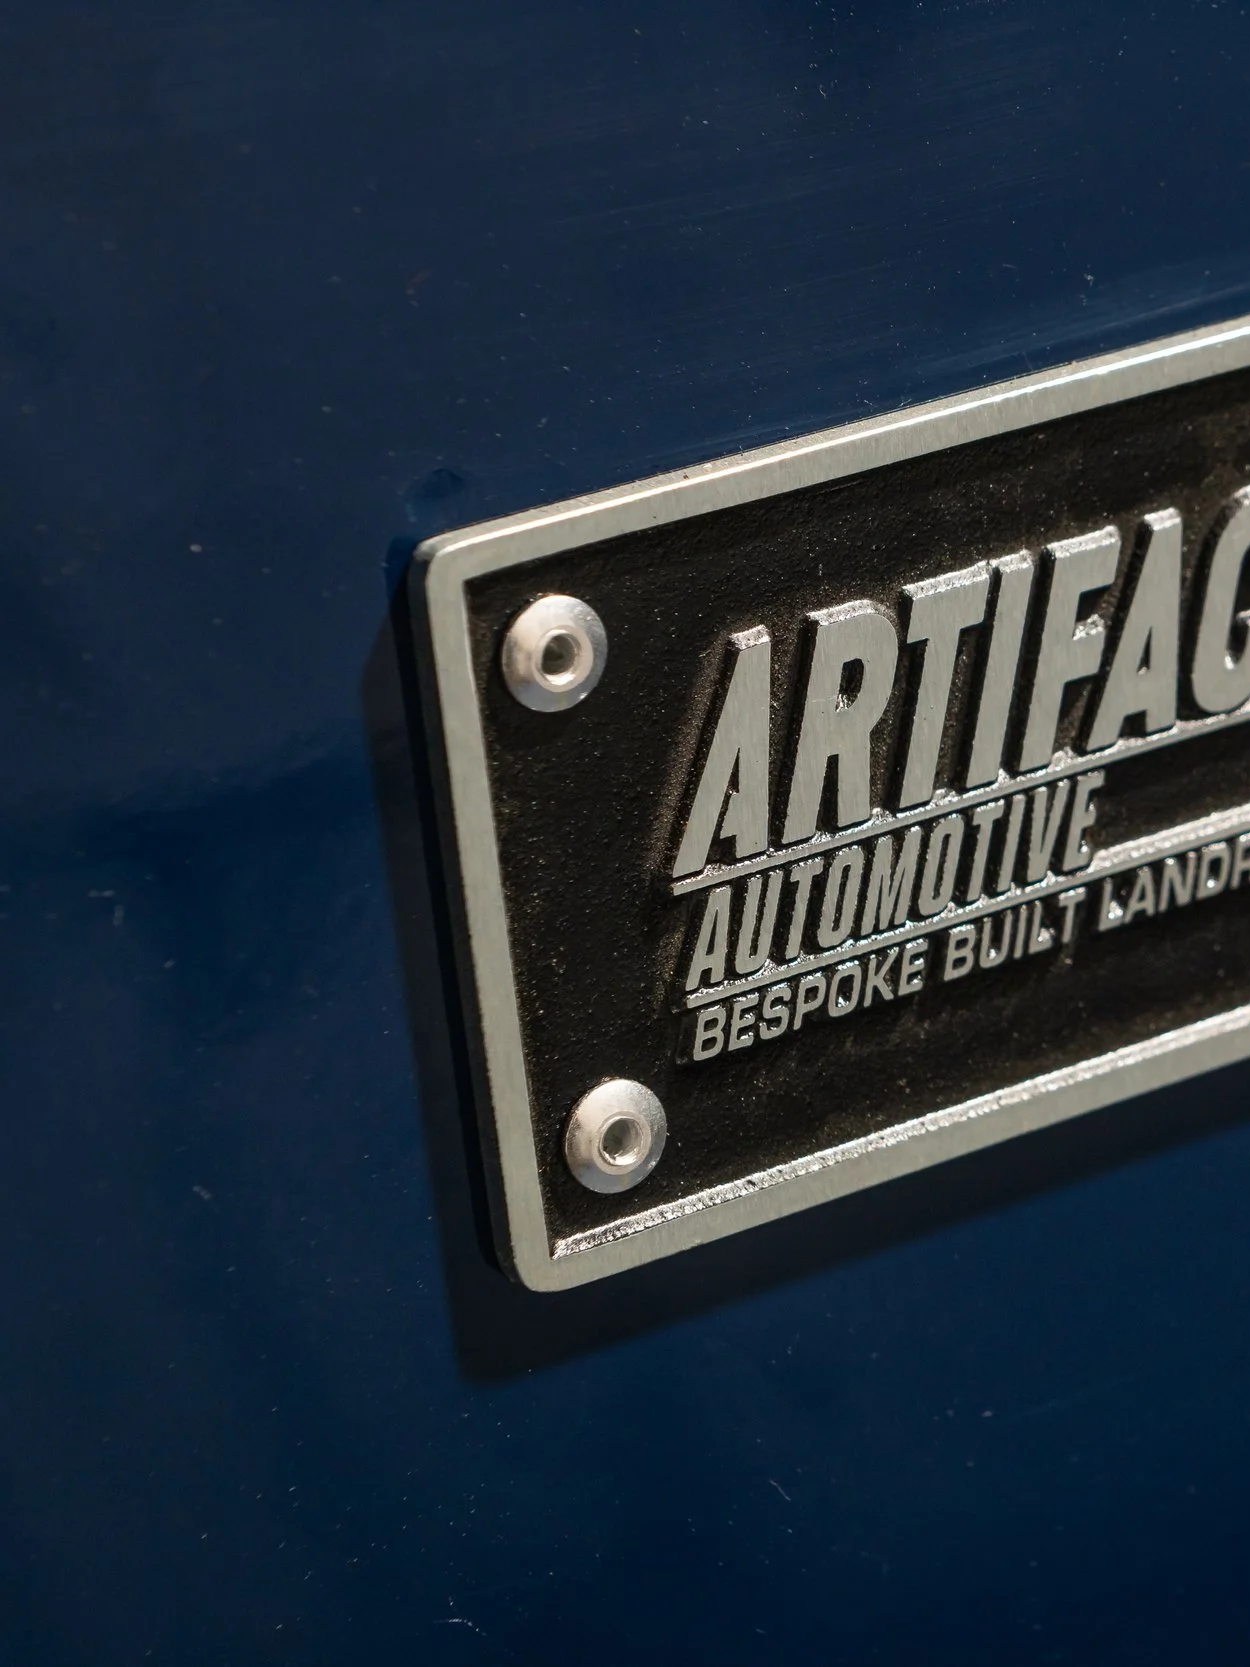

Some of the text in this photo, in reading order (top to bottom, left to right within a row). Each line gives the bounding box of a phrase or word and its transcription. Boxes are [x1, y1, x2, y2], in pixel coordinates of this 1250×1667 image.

[686, 771, 1105, 991] AUTOMOTIVE
[691, 950, 926, 1063] BESPOKE
[943, 888, 1086, 983] BUILT
